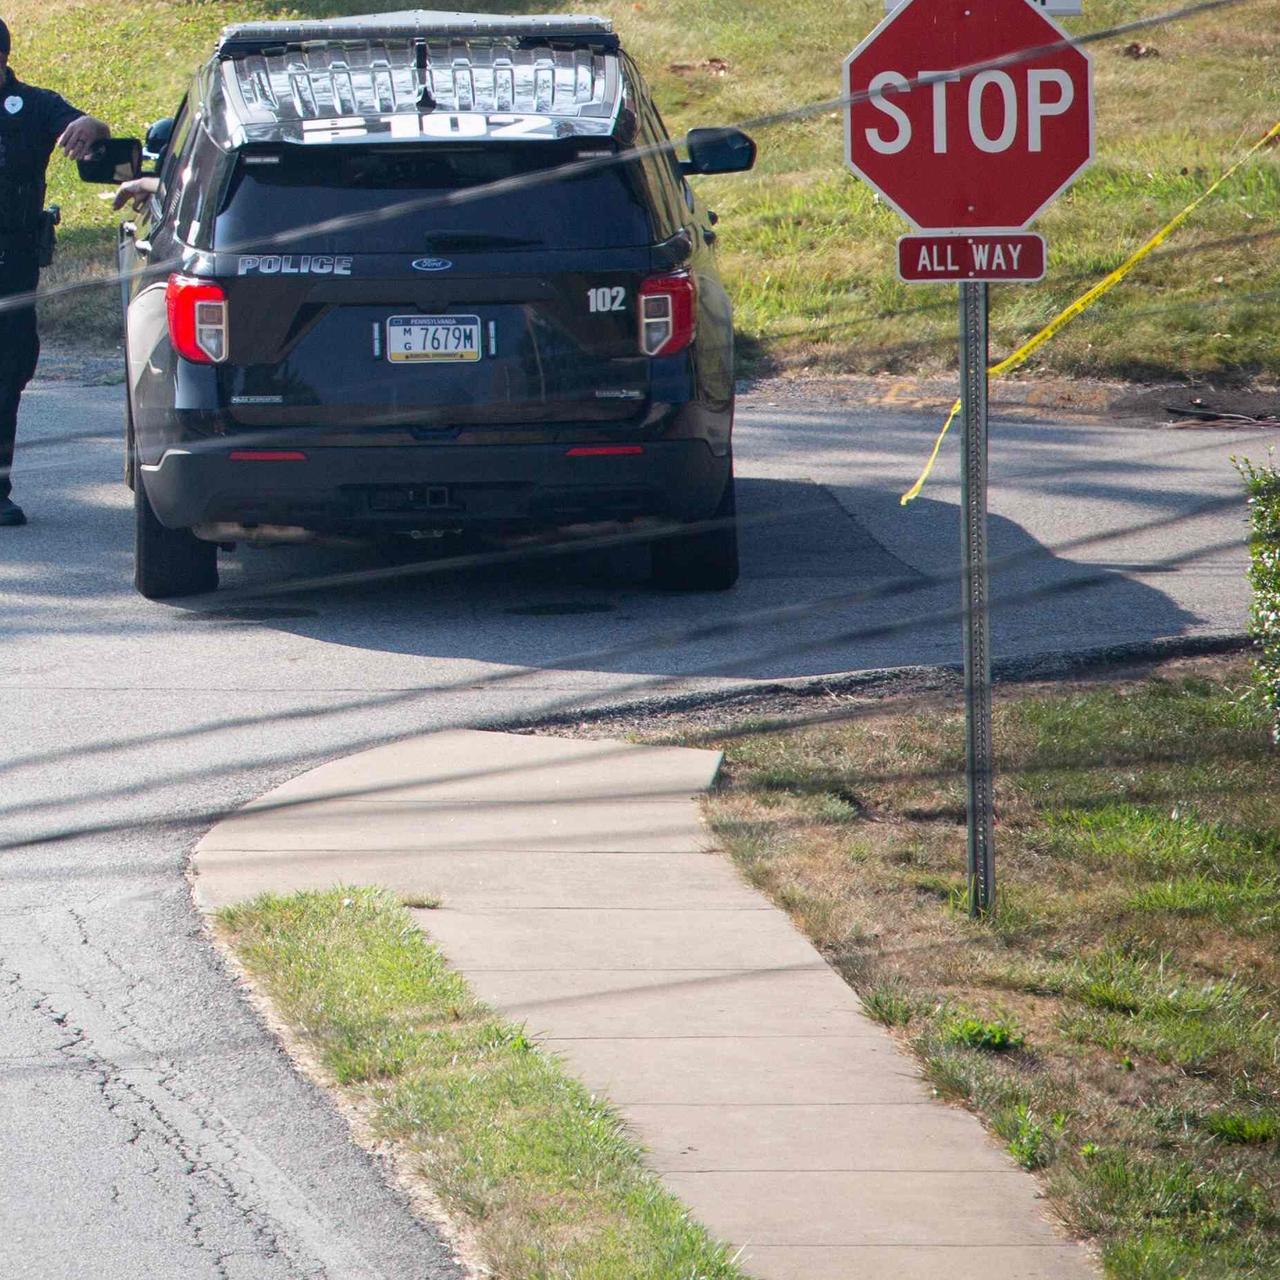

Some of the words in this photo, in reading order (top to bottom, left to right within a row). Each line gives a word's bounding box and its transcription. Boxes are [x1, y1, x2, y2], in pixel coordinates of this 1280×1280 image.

[864, 68, 1075, 155] STOP
[380, 114, 554, 138] 102
[237, 255, 353, 276] POLICE
[917, 245, 959, 272] ALL
[972, 243, 1022, 271] WAY
[587, 286, 626, 312] 102
[403, 328, 412, 336] M
[420, 326, 474, 350] 7679M
[404, 342, 412, 351] G
